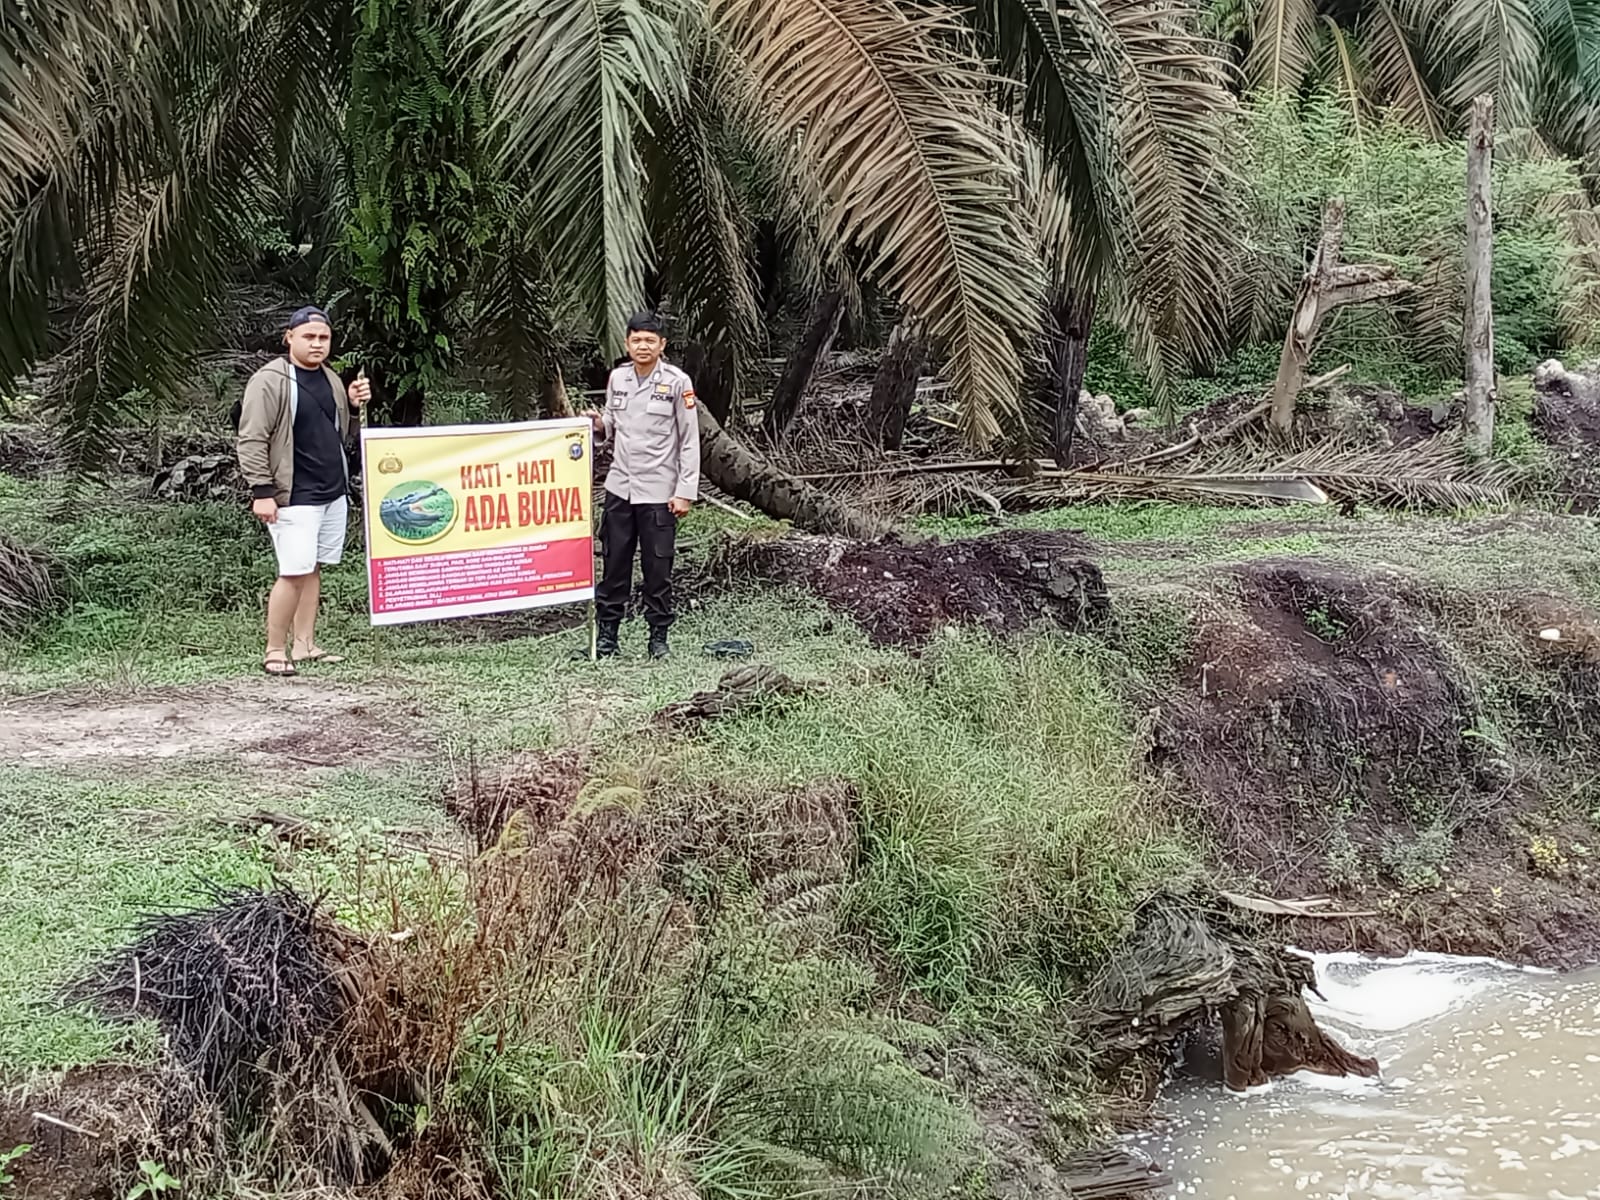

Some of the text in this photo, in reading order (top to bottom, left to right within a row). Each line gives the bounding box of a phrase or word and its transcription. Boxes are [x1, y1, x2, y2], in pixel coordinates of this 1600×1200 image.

[460, 463, 501, 490] HATI
[517, 459, 556, 485] HATI
[464, 487, 584, 532] ADA BUAYA
